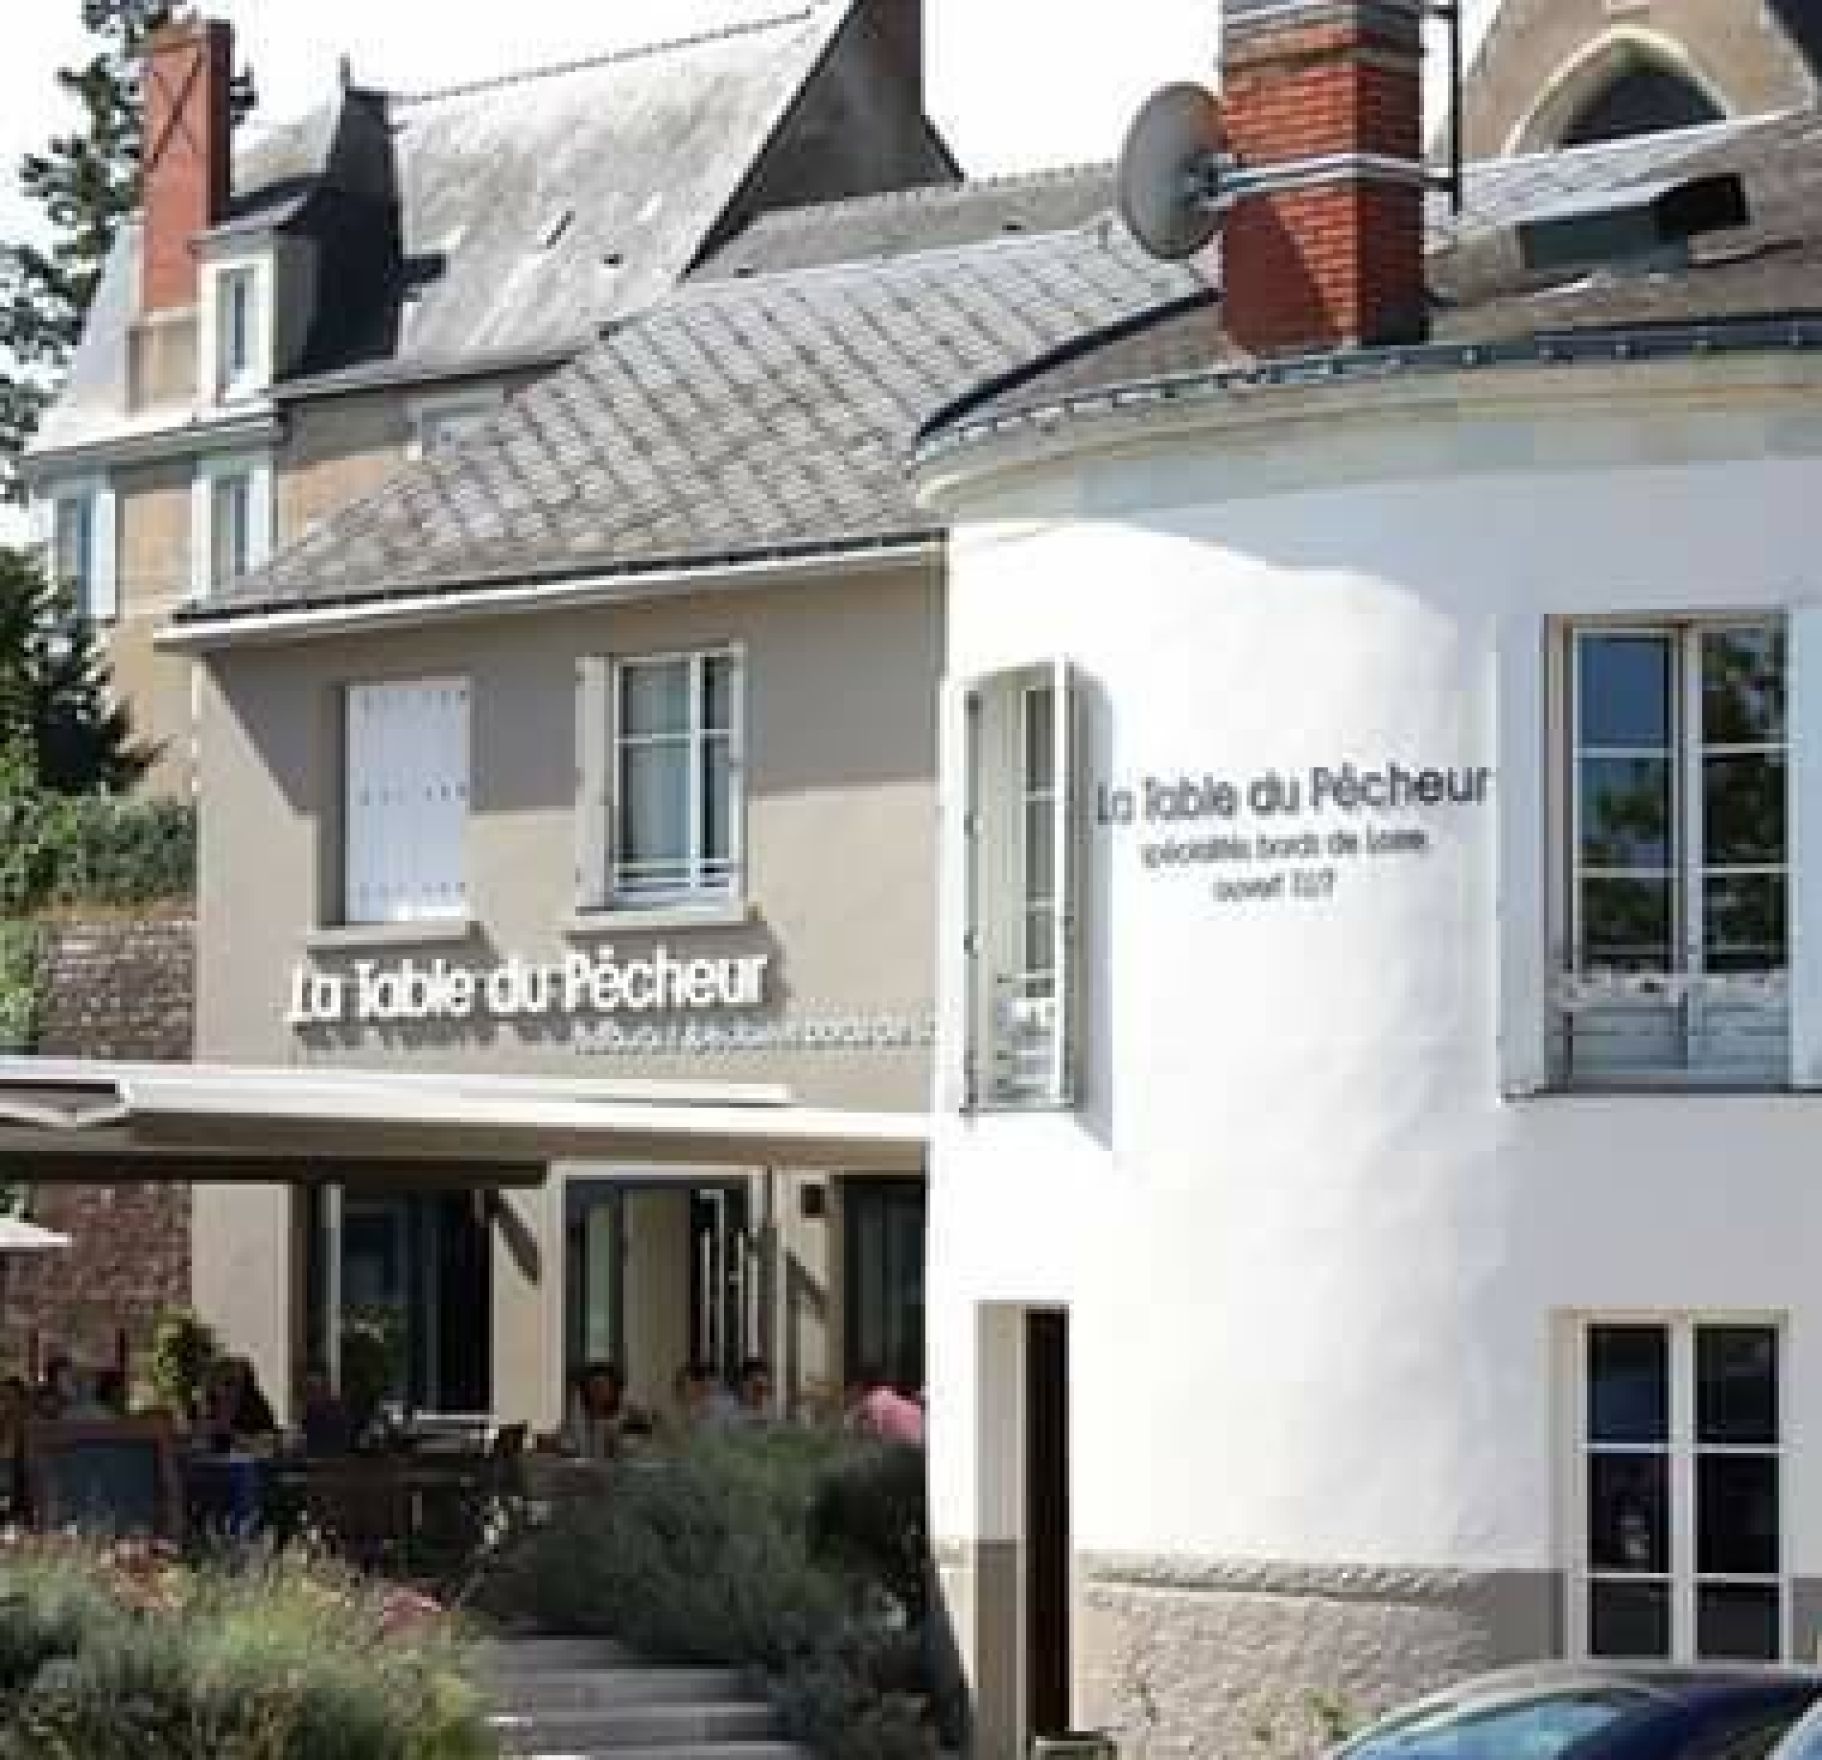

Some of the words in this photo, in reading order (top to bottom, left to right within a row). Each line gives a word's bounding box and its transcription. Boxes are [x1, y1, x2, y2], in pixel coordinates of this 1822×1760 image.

[1096, 780, 1135, 825] La
[1142, 774, 1237, 821] Table
[1247, 768, 1302, 816] du
[1309, 762, 1491, 809] Pêcheur
[1327, 829, 1358, 856] de
[286, 964, 342, 1022] La
[354, 958, 473, 1019] Table
[488, 954, 559, 1014] du
[563, 945, 770, 1013] Pêcheur
